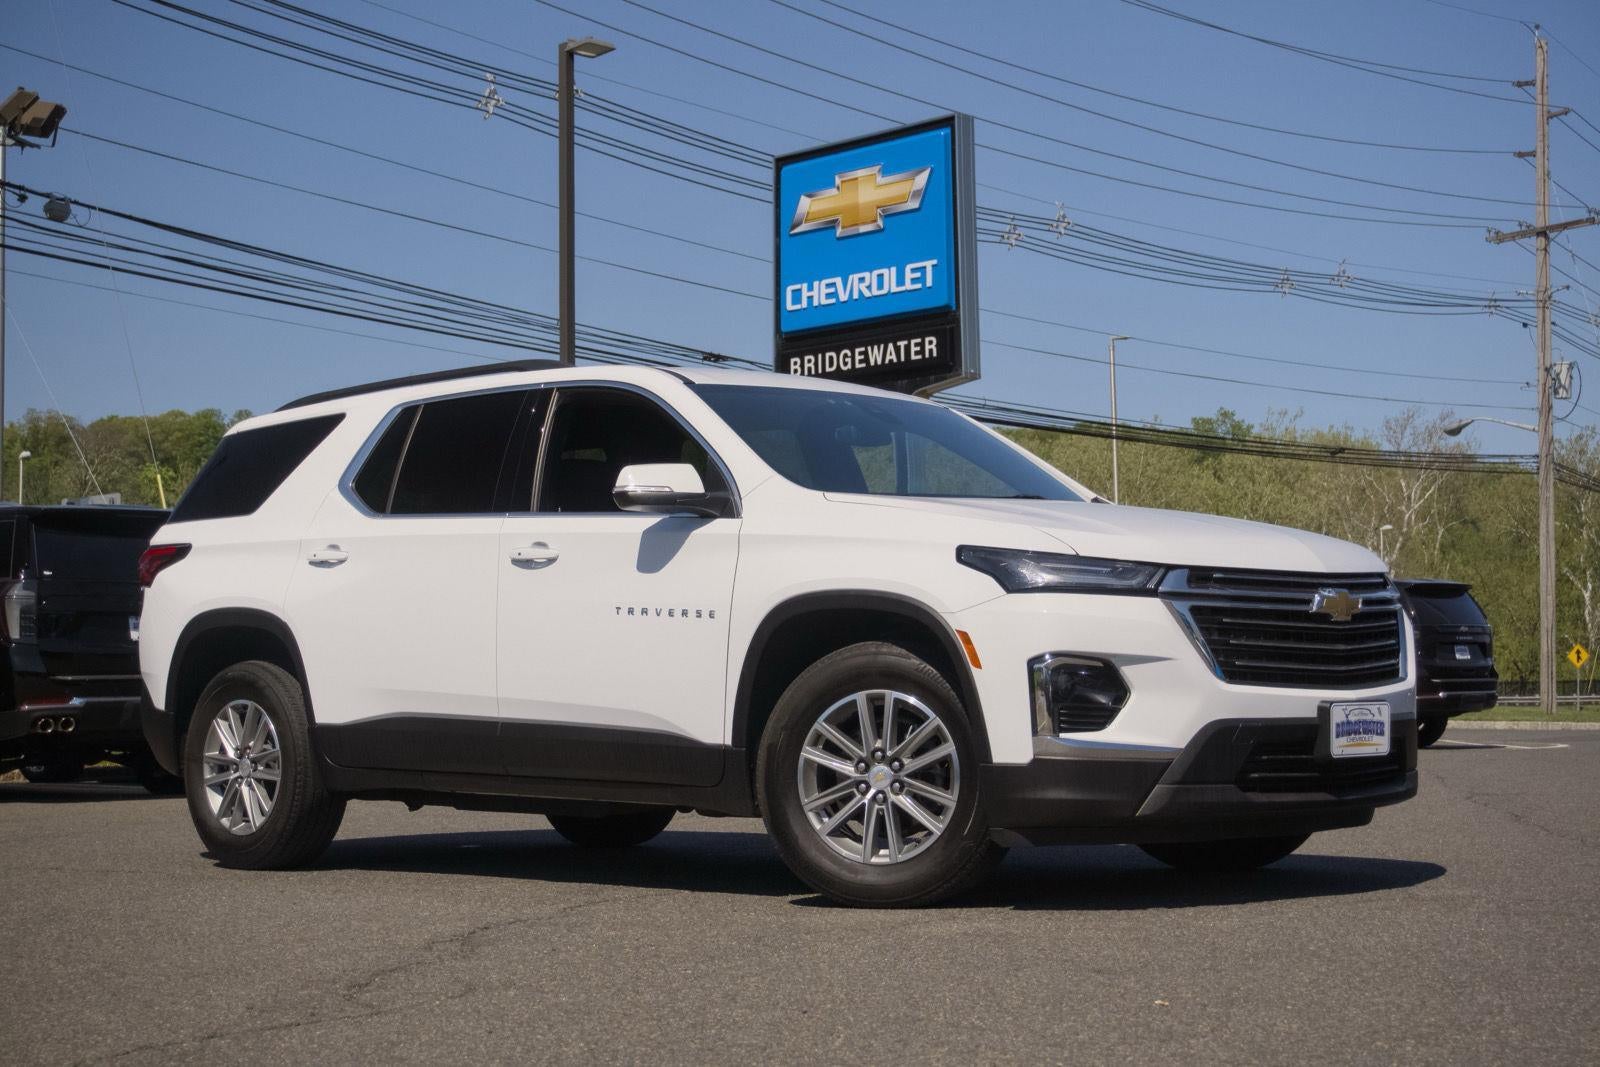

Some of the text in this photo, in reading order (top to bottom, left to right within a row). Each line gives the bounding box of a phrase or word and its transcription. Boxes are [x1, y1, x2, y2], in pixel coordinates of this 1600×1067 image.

[786, 259, 938, 311] CHEVROLET
[790, 336, 938, 376] BRIDGEWATER
[615, 606, 716, 619] TRAVERSE
[1335, 720, 1385, 738] BRIDGEWATER
